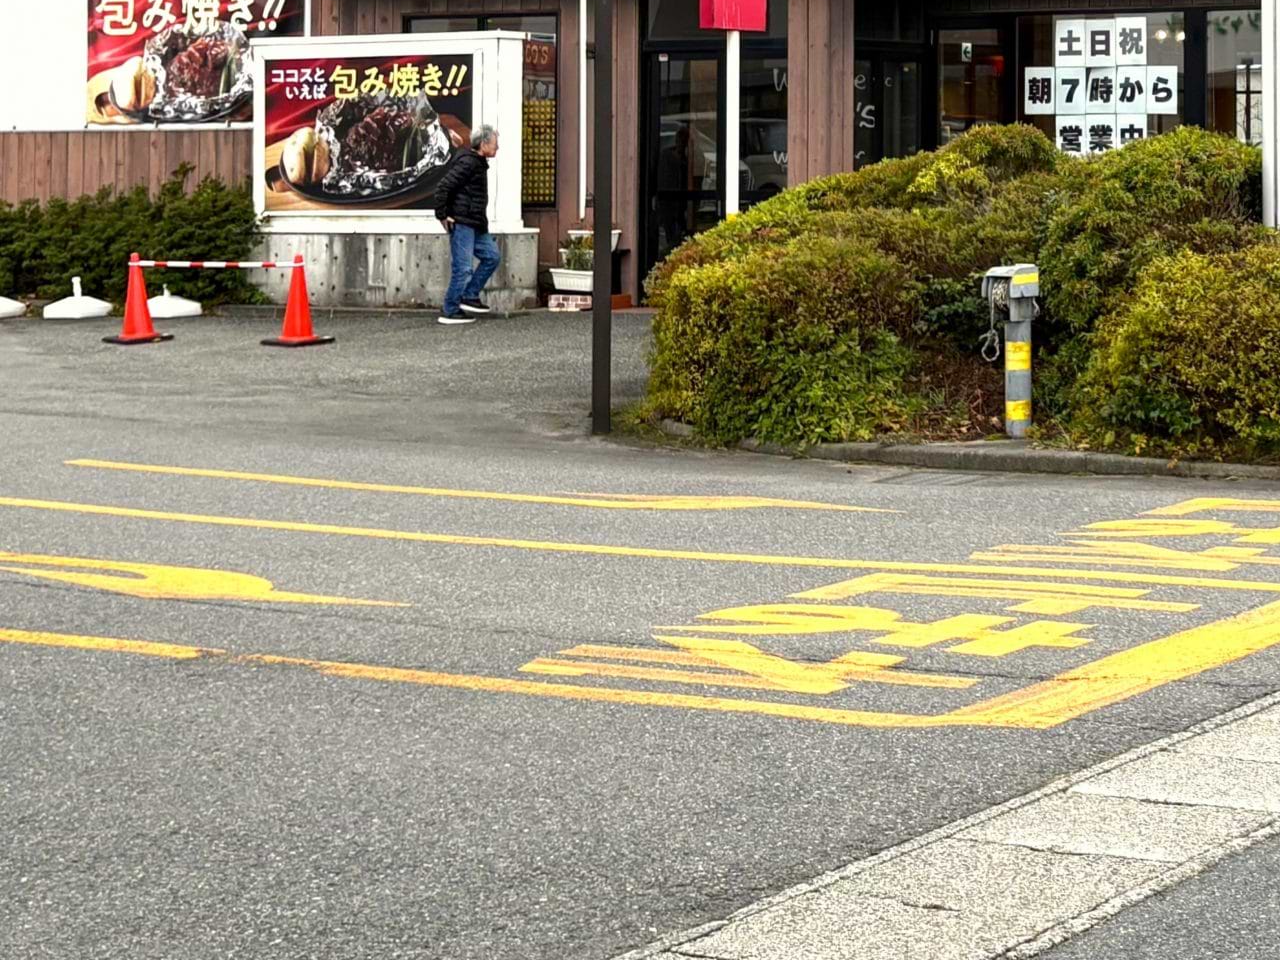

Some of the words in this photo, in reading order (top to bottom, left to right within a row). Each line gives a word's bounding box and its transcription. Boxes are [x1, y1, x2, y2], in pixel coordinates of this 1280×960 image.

[1059, 28, 1143, 56] 土日祝
[272, 68, 325, 83] ココスと
[286, 84, 327, 100] いえば
[1028, 76, 1172, 104] 朝7時から
[1060, 124, 1143, 152] 営業中
